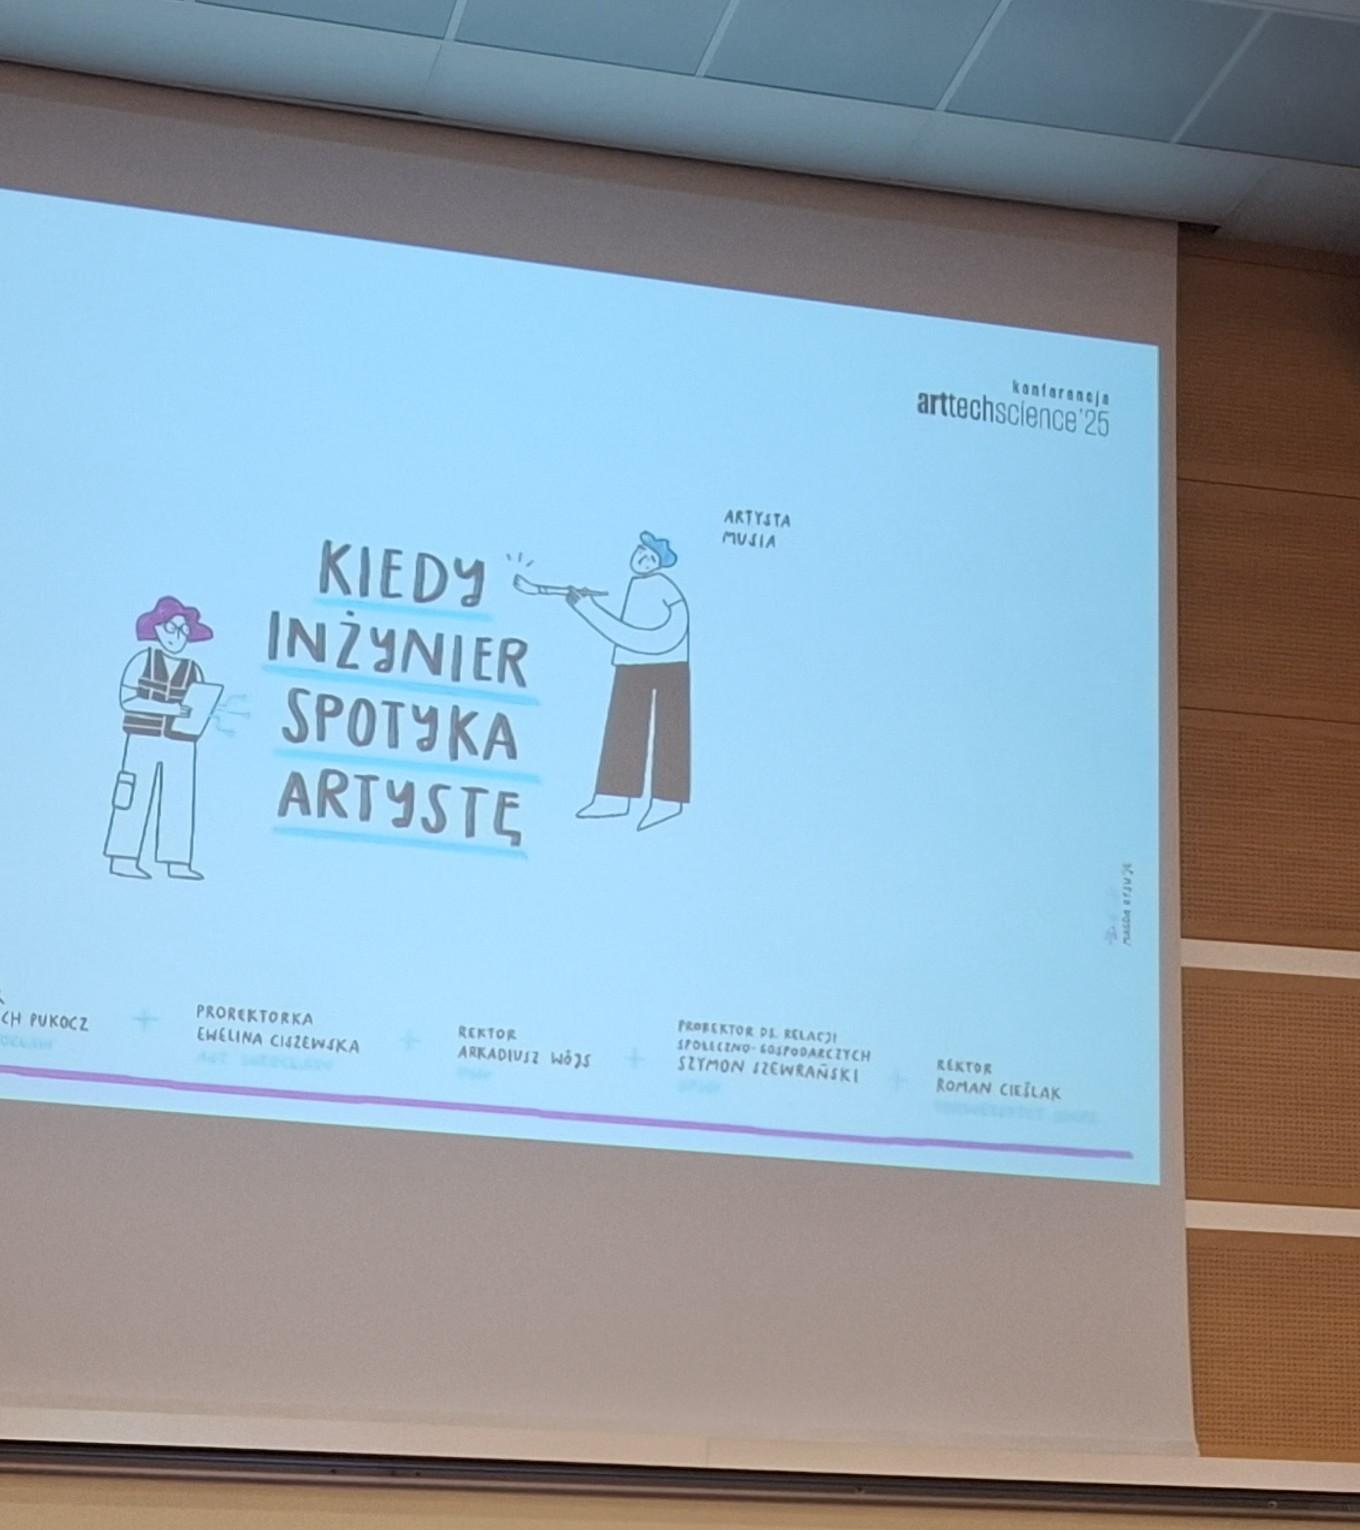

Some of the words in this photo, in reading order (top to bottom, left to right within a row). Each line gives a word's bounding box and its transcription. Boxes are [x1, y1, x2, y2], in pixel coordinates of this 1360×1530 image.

[1012, 379, 1109, 407] konferencja
[723, 509, 791, 528] ARTYSTA
[319, 539, 485, 608] KIEDY
[267, 610, 529, 688] INŻYNIER
[281, 687, 518, 762] SPOTYKA
[277, 768, 522, 847] ARTYSTĘ
[30, 1012, 89, 1032] PUKOCZ
[196, 1003, 314, 1026] PROREKTORKA
[197, 1026, 263, 1046] EWELINA
[270, 1033, 360, 1054] CISZEWSKA
[458, 1025, 517, 1041] REKTOR
[677, 1019, 754, 1037] PROREKTOR
[784, 1028, 838, 1044] RELACJI
[457, 1045, 539, 1065] ARKADIUSZ
[937, 1058, 992, 1075] REKTOR
[677, 1055, 745, 1074] SZYMON
[752, 1061, 859, 1084] SZEWRAŃSKI
[936, 1077, 992, 1095] ROMAN
[1000, 1081, 1062, 1101] CIEŚLAK
